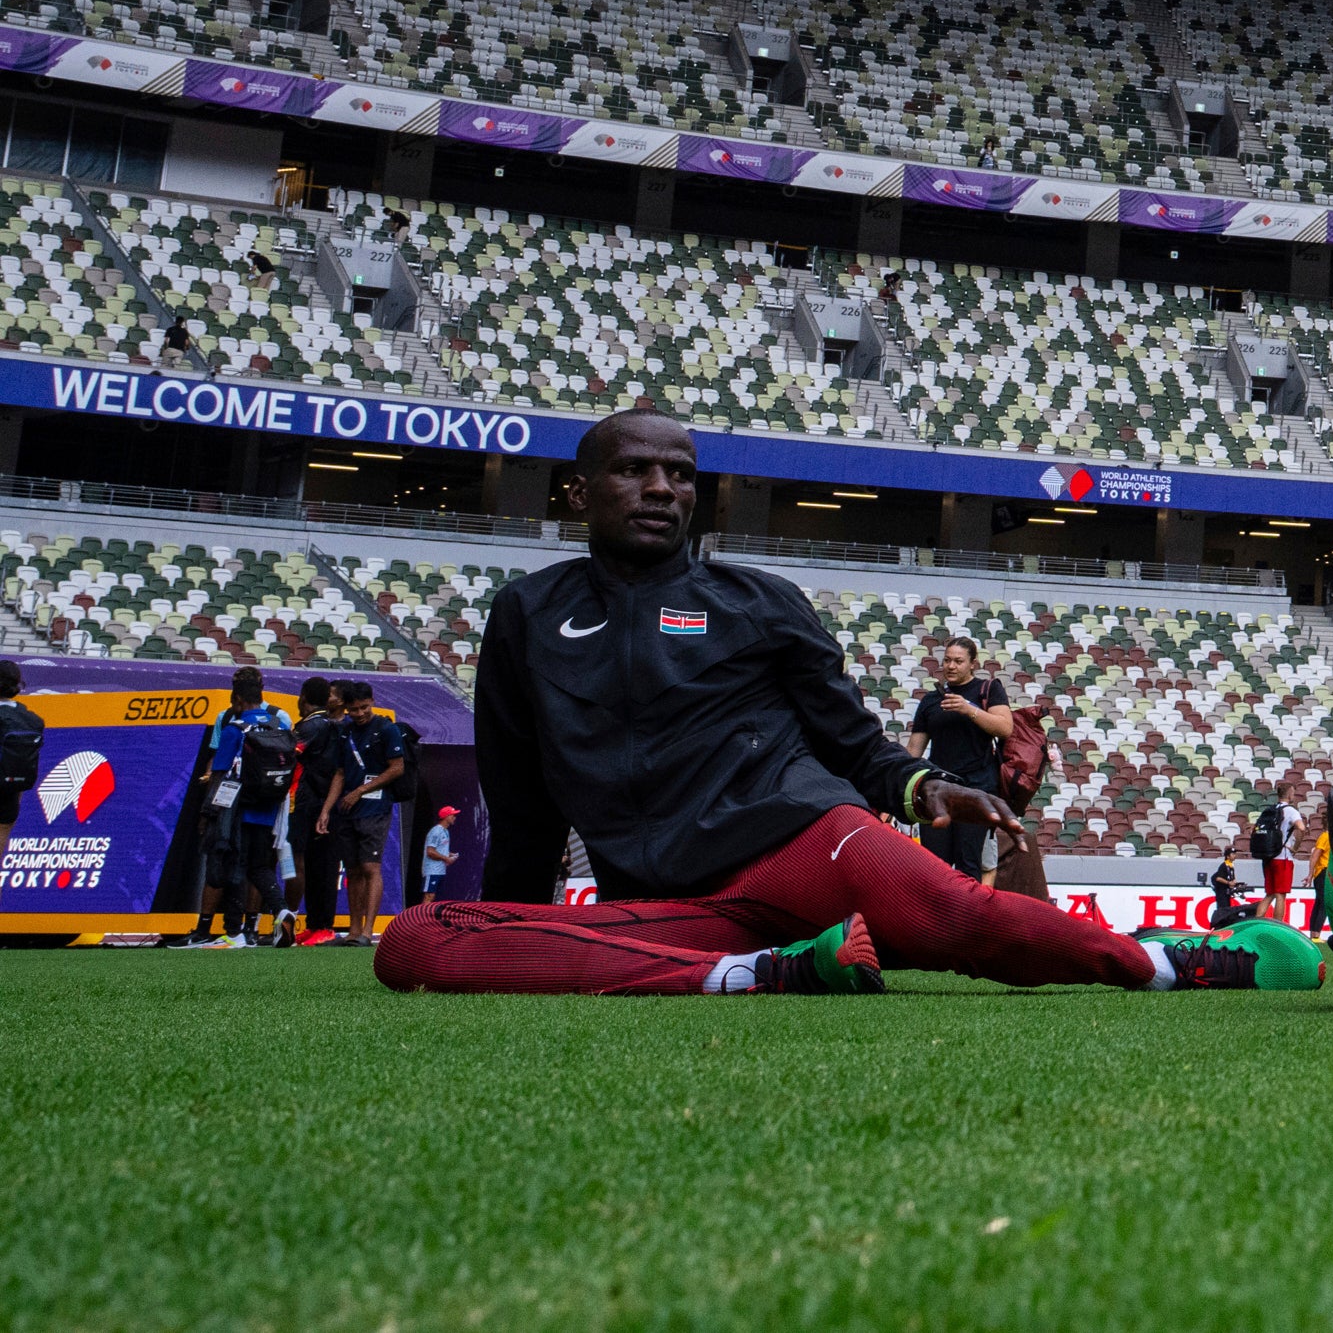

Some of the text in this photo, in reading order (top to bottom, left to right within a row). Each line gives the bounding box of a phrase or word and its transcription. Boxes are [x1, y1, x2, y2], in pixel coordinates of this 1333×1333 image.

[369, 251, 393, 263] 227
[841, 306, 861, 317] 226
[1269, 346, 1287, 356] 225
[53, 367, 530, 453] WELCOME TO TOKYO
[1100, 471, 1172, 484] WORLD ATHLETICS
[1100, 480, 1171, 493] CHAMPIONSHIPS
[124, 696, 209, 721] SEIKO
[8, 837, 111, 852] WORLD ATHLETICS
[2, 853, 106, 869] CHAMPIONSHIPS
